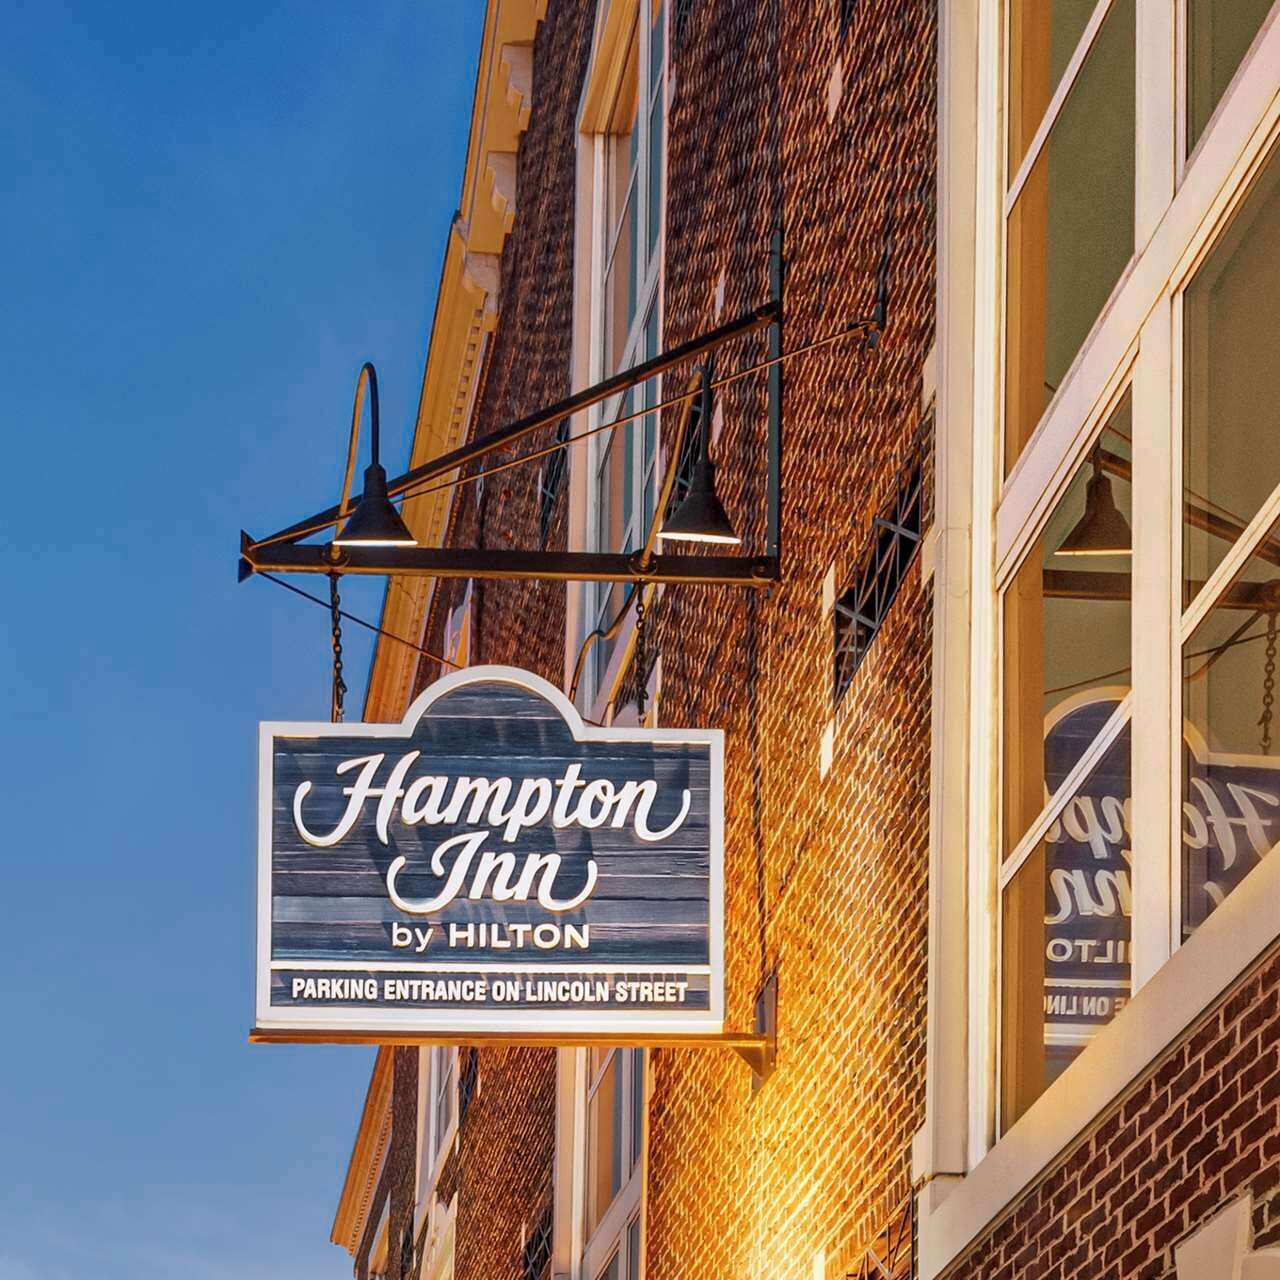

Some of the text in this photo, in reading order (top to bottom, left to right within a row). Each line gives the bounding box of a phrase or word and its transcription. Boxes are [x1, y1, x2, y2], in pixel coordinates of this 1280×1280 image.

[294, 751, 691, 846] Hampton
[387, 831, 597, 913] Inn
[392, 922, 590, 953] by HILTON
[292, 978, 689, 1003] PARKING ENTRANCE ON LINCOLN STREET
